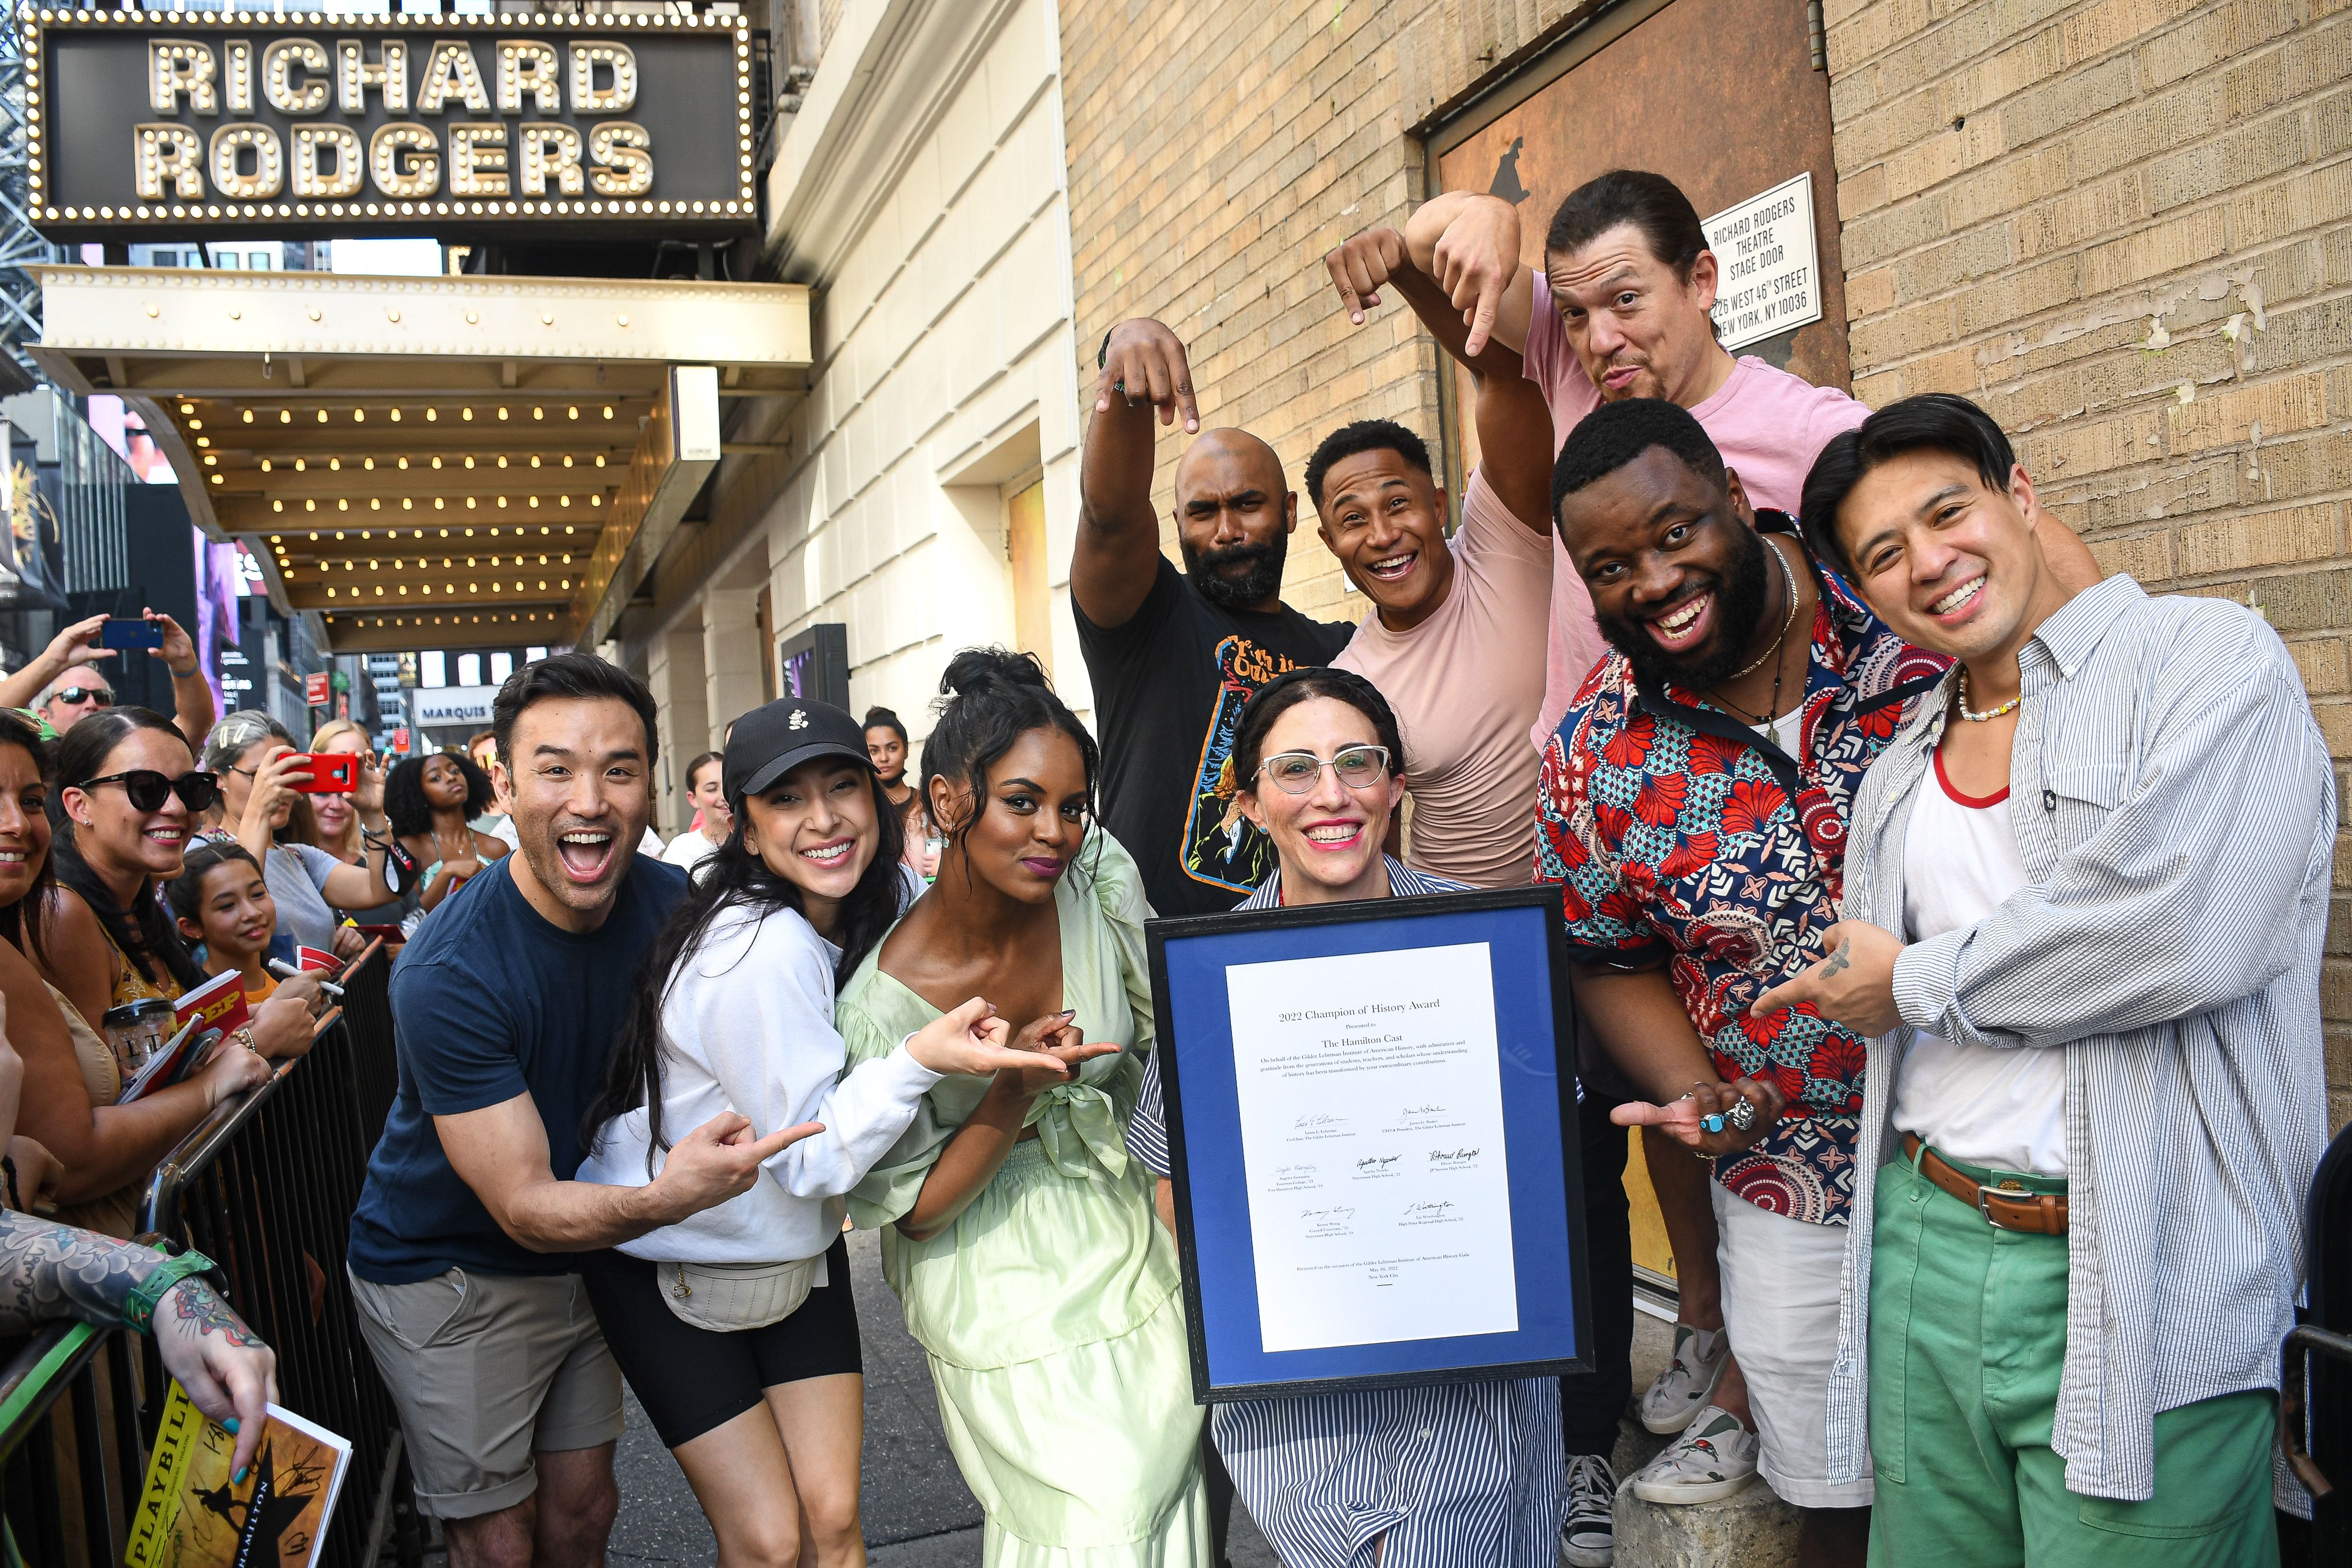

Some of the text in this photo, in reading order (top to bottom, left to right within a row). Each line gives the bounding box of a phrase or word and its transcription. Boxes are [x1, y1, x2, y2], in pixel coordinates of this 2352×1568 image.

[148, 37, 638, 116] RICHARD
[134, 121, 653, 200] RODGERS
[1714, 197, 1795, 247] RICHARD RODGERS
[1736, 228, 1774, 256] THEATRE
[1731, 245, 1783, 280] STAGE DOOR
[1731, 288, 1754, 311] WEST
[1774, 267, 1807, 294] STREET
[1737, 309, 1763, 333] YORK,
[1765, 302, 1776, 321] NY
[1779, 291, 1807, 316] 10036
[423, 707, 485, 720] MARQUIS
[1279, 999, 1440, 1022] 2022 Champion of History Award
[1321, 1040, 1339, 1048] The
[1342, 1037, 1381, 1046] Hamilton
[239, 1481, 268, 1568] HAMILTON
